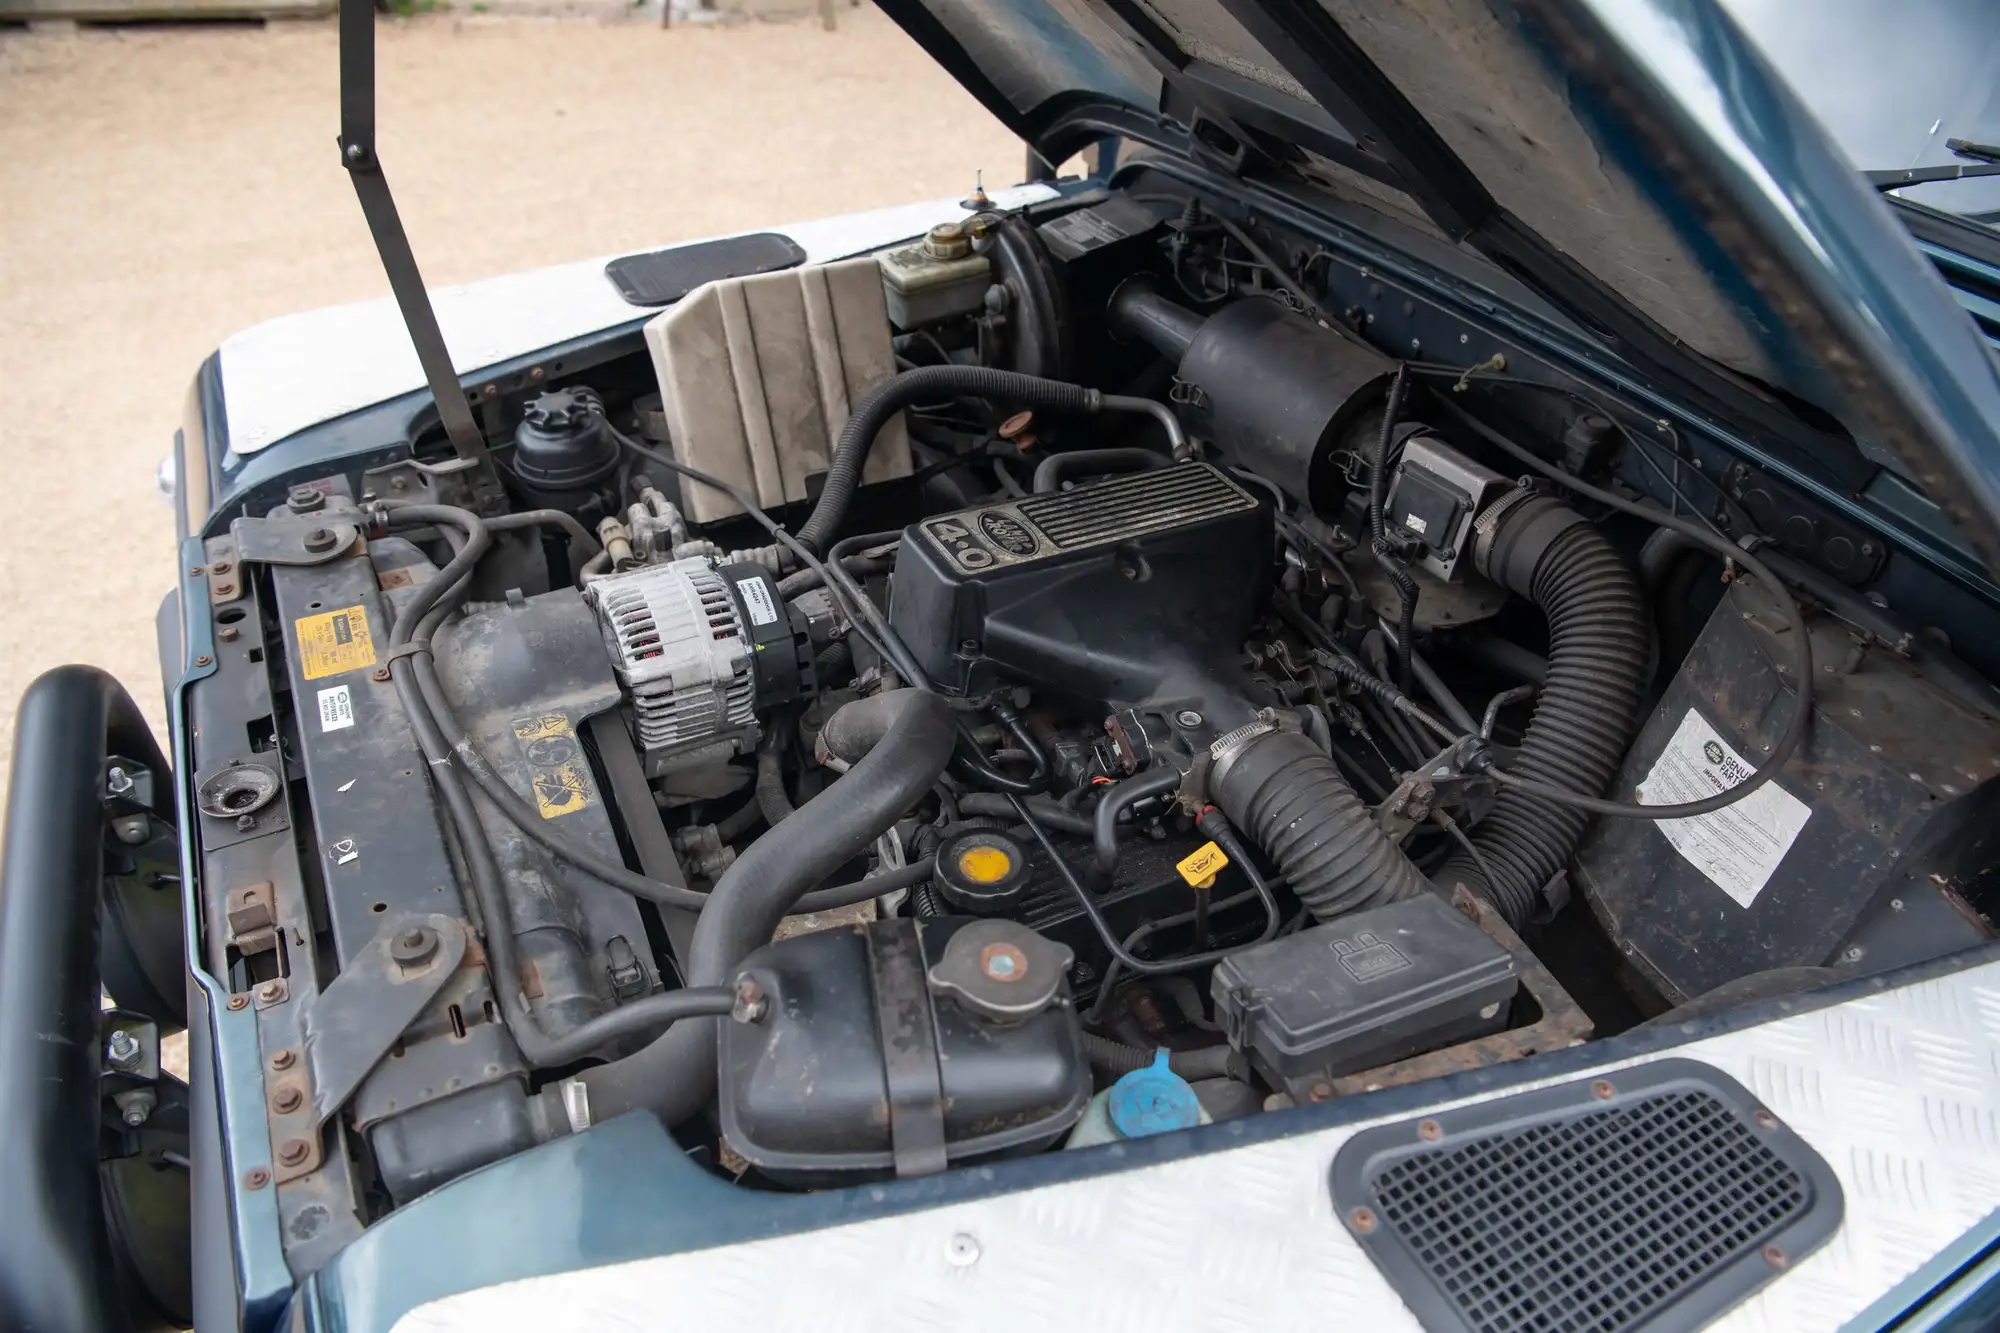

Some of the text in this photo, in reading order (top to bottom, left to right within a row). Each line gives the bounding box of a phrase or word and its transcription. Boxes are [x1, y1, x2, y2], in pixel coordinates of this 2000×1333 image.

[984, 521, 1024, 552] ROVER
[997, 520, 1030, 543] LAND
[1725, 756, 1751, 779] GENU
[1703, 768, 1727, 791] IMPORTAN
